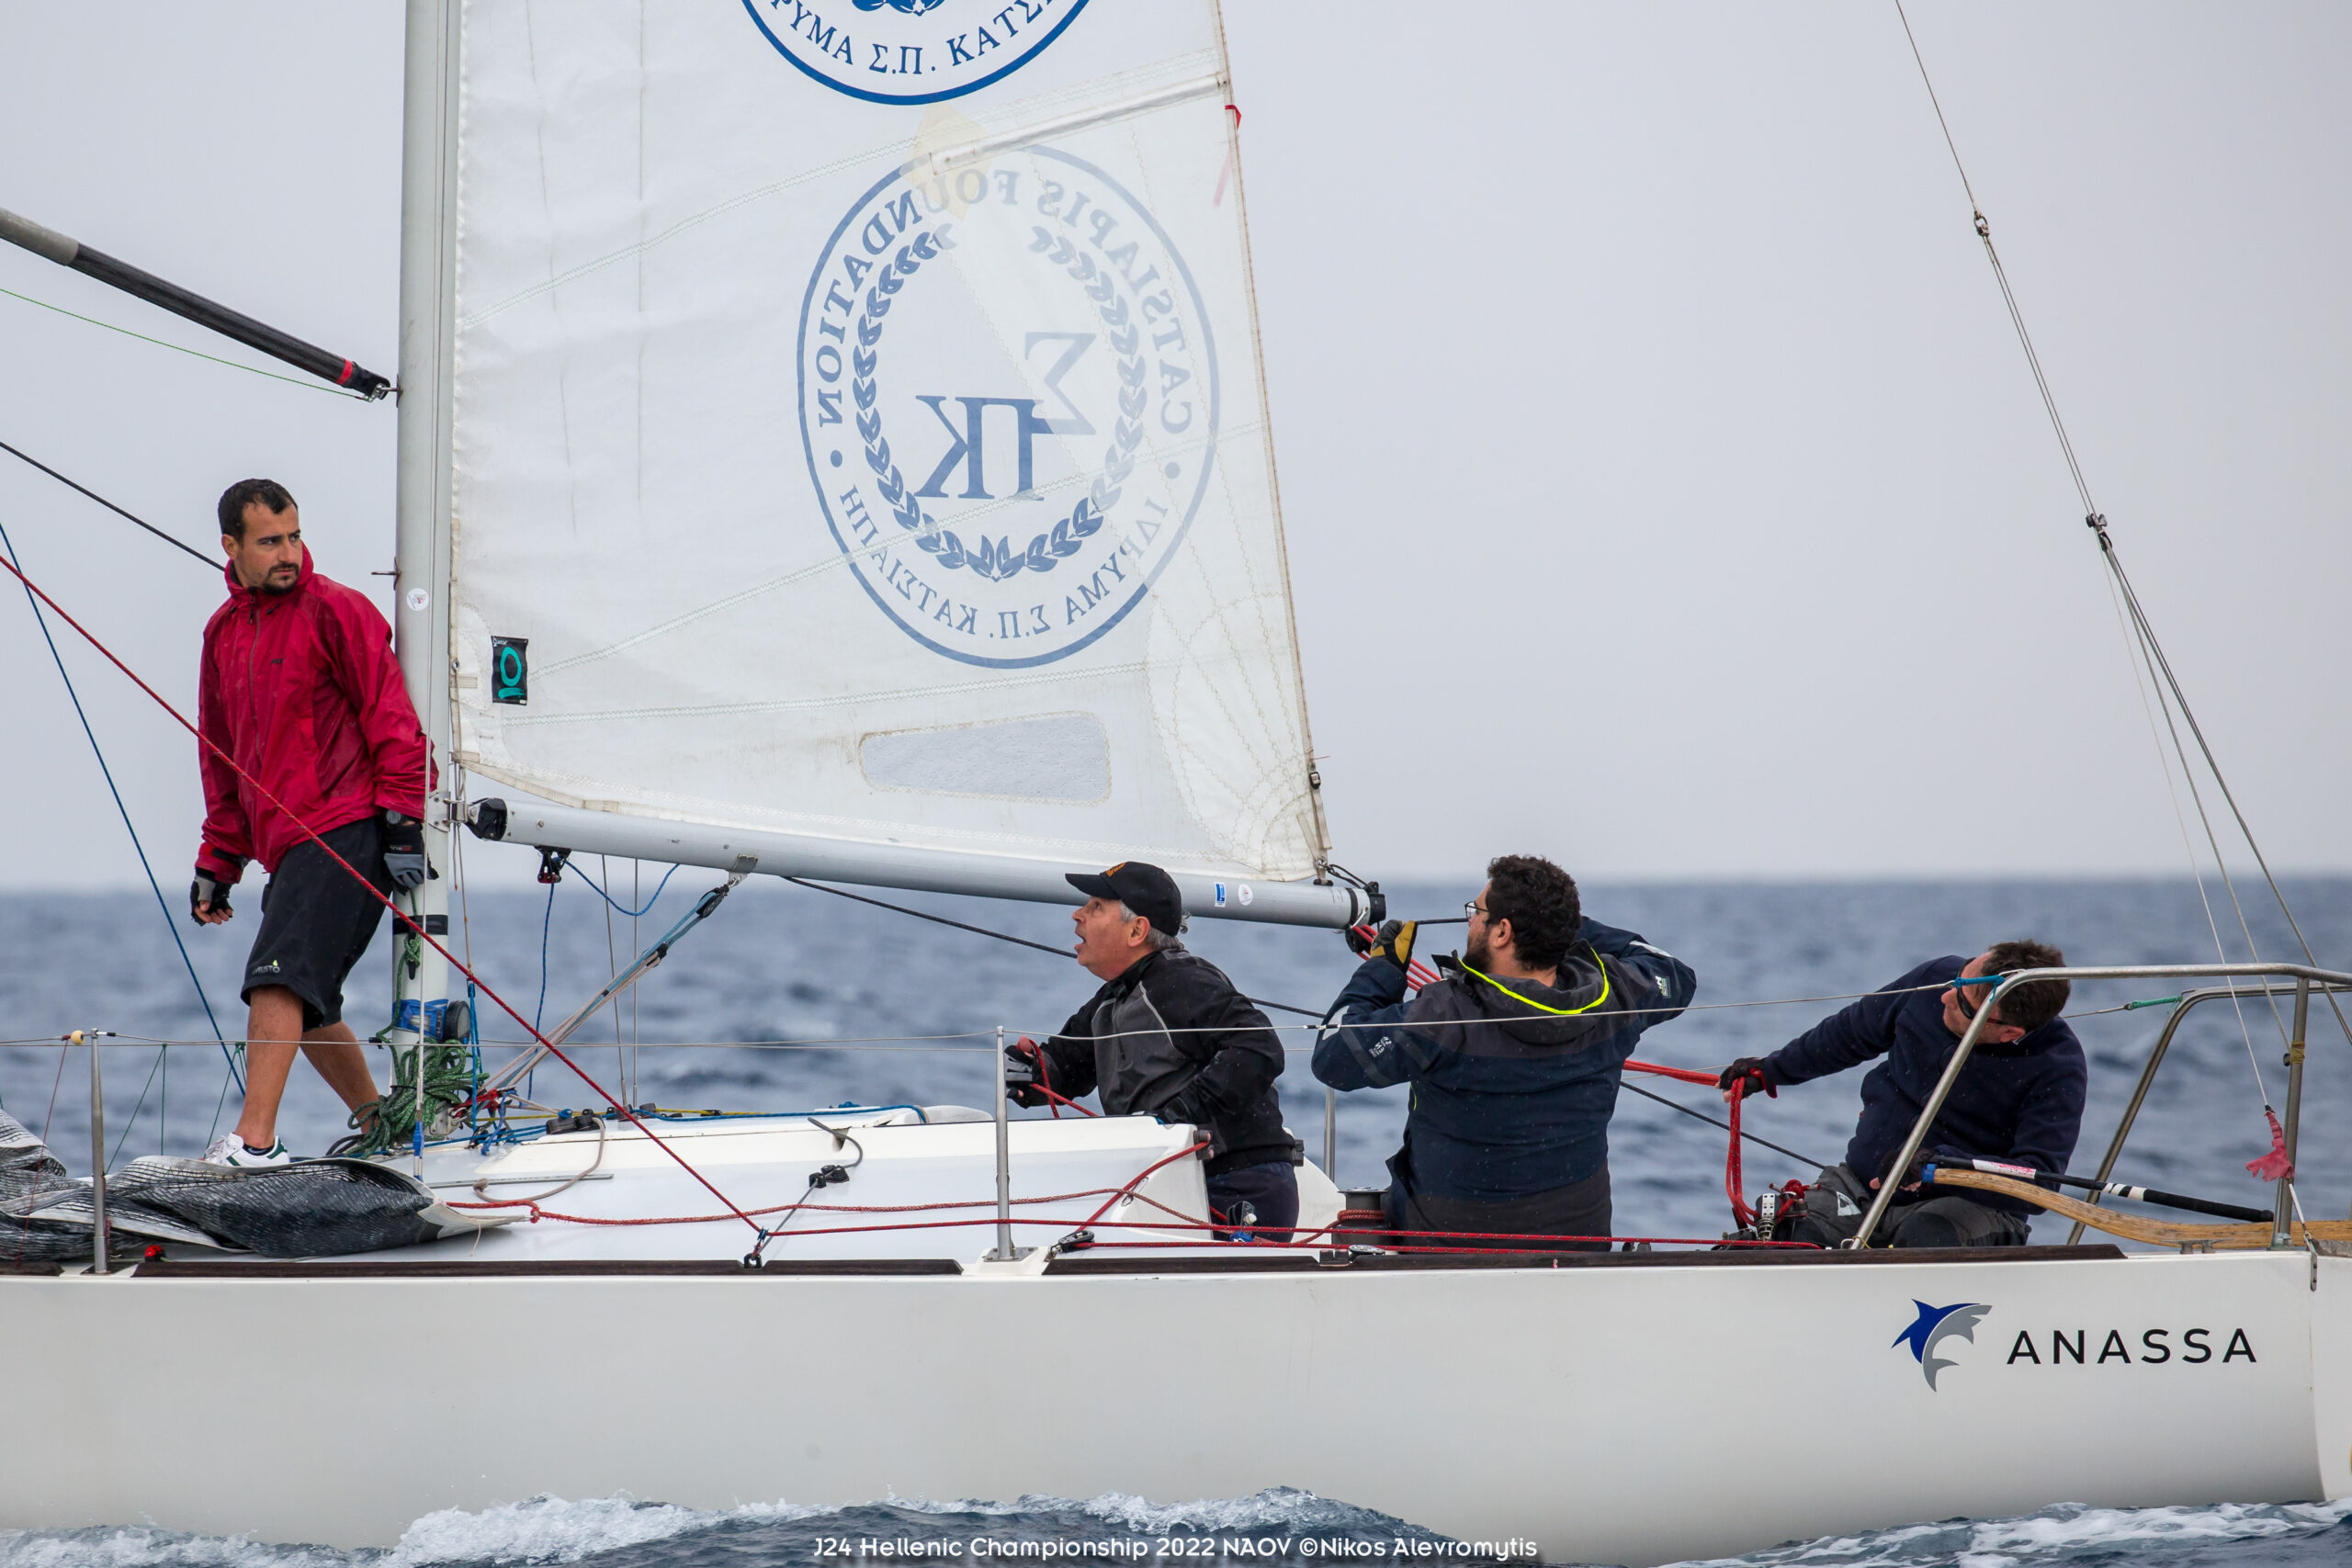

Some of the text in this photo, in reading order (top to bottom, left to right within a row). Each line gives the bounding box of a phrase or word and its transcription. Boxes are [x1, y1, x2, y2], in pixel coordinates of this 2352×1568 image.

[868, 43, 936, 74] Σ.Π.
[946, 0, 1052, 66] ΚΑΤΣ
[2007, 1328, 2257, 1364] ANASSA
